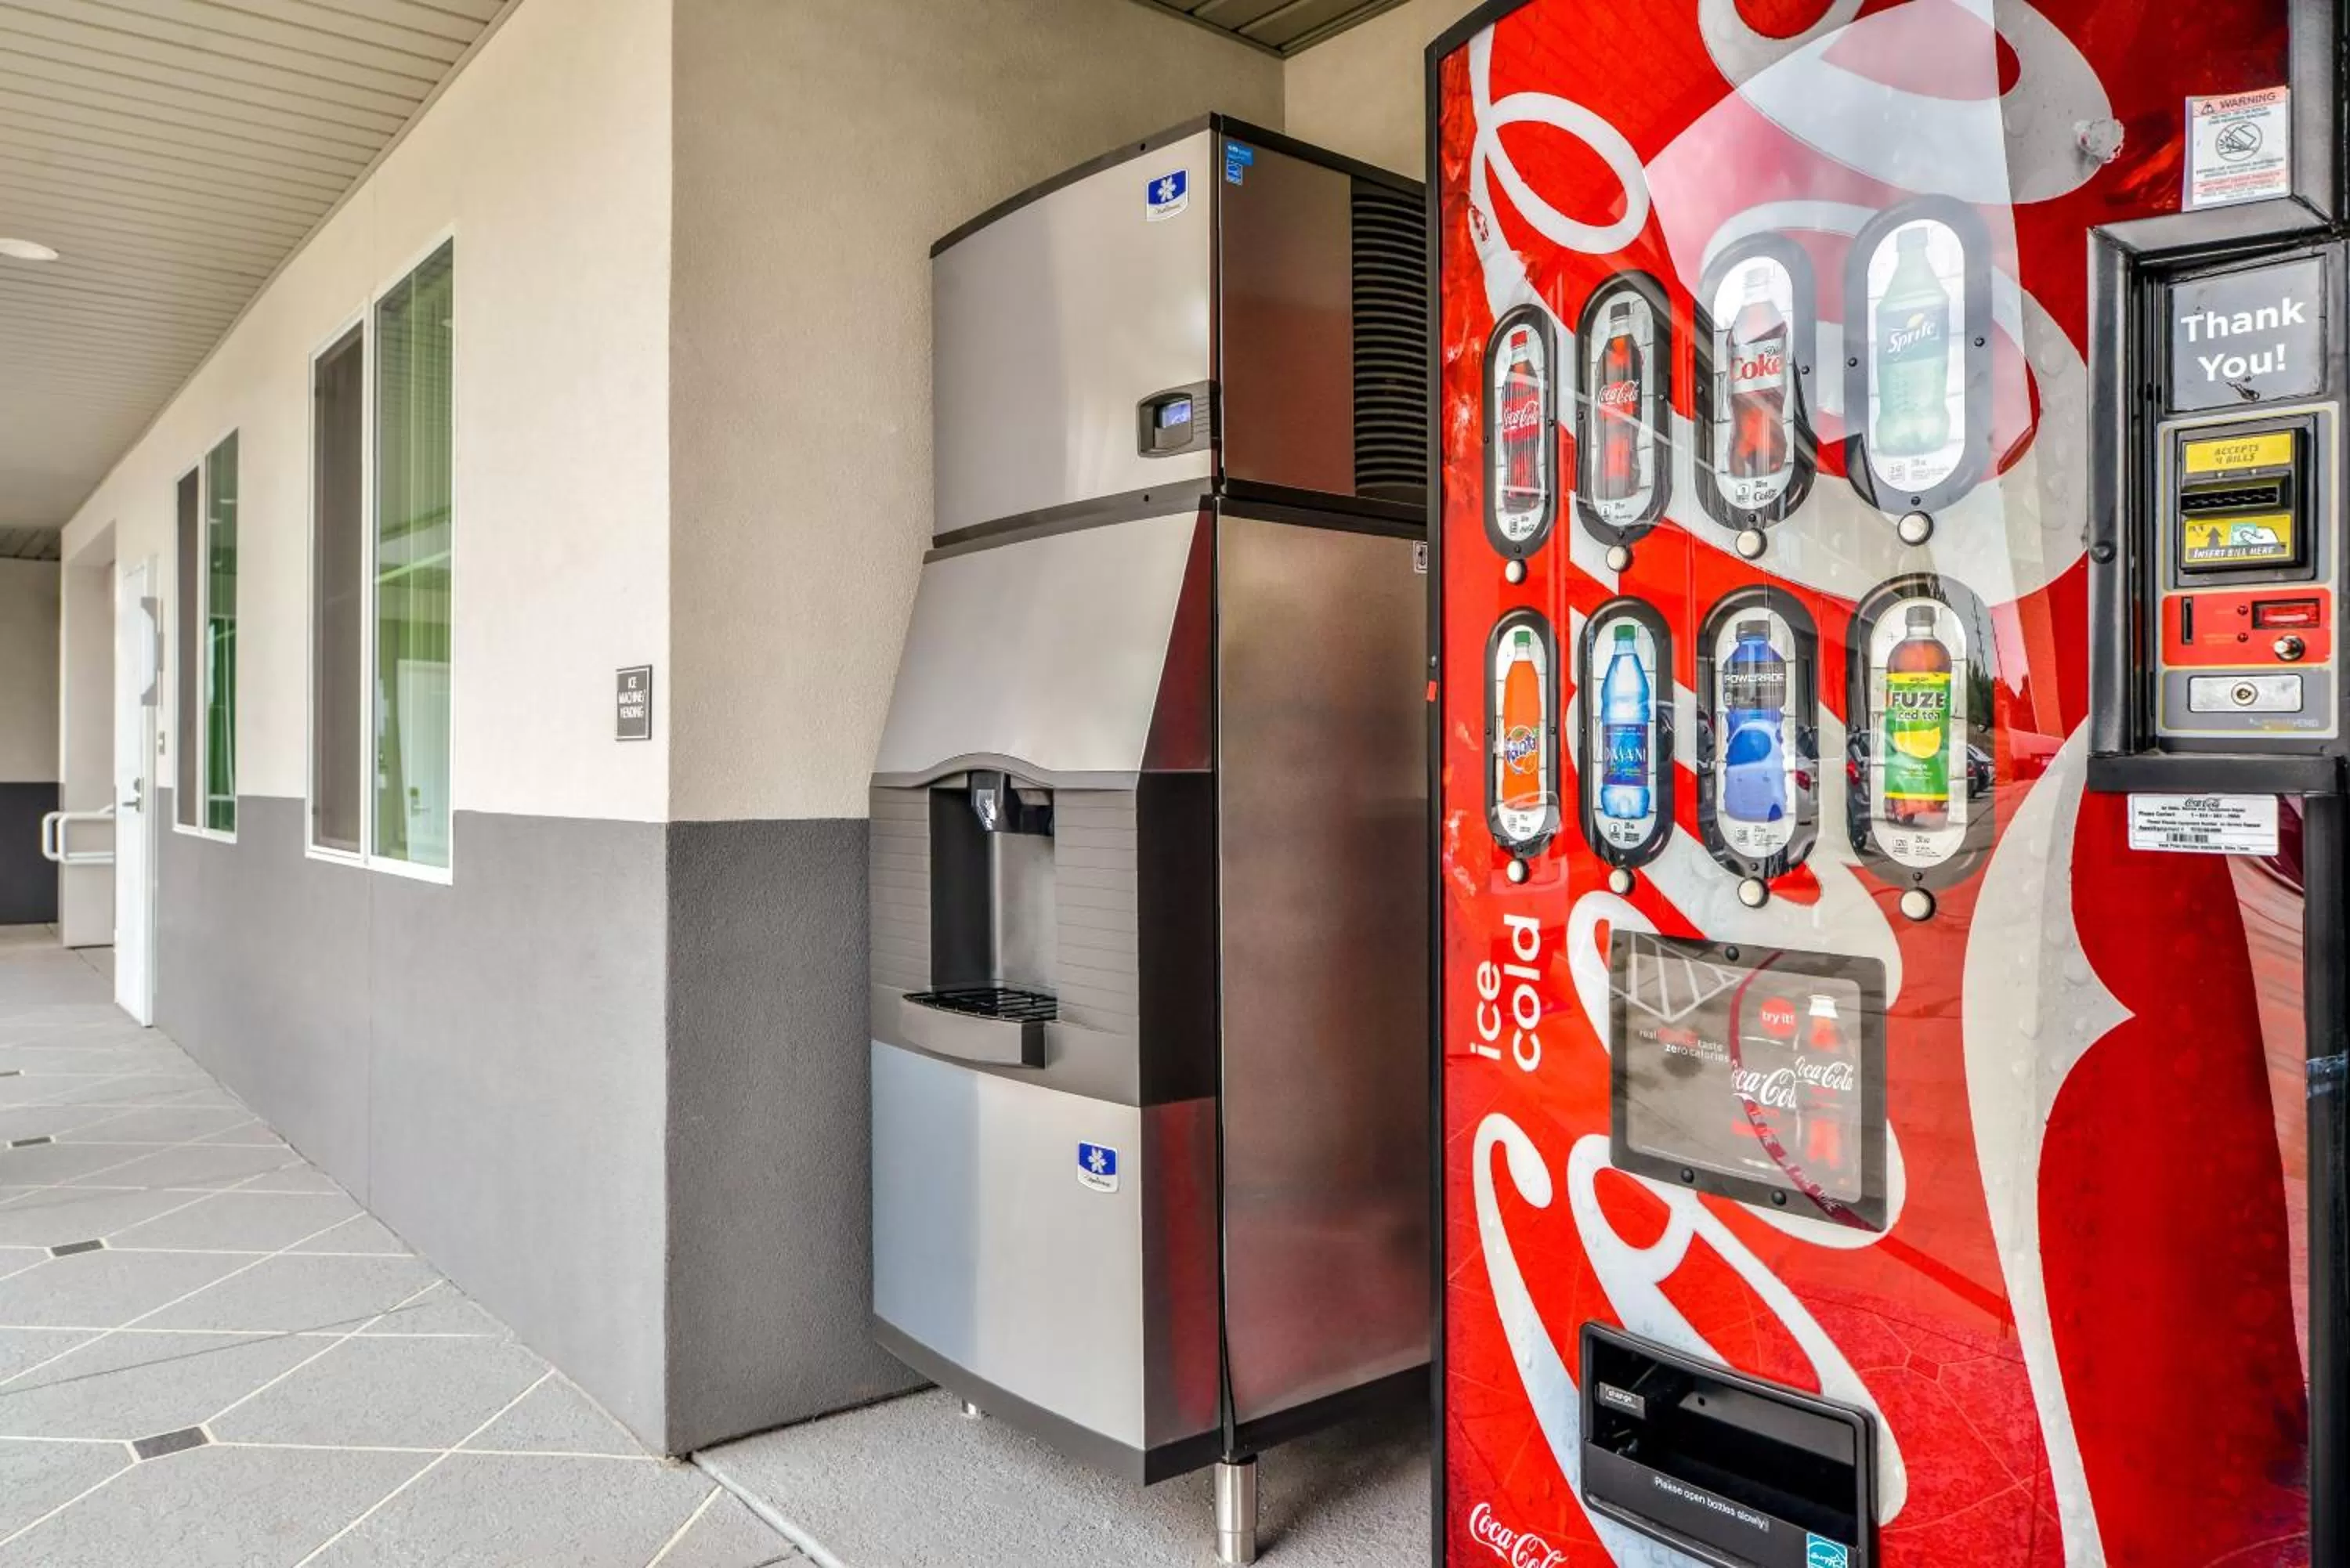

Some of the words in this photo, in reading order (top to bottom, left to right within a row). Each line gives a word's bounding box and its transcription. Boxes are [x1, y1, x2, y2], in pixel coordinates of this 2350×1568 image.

[2220, 92, 2276, 109] WARNING
[2180, 297, 2306, 342] Thank
[1888, 321, 1936, 352] Sprite
[1730, 353, 1781, 382] Coke
[2197, 344, 2286, 381] You!
[2214, 444, 2259, 455] ACCEPTS
[2226, 452, 2256, 464] BILLS
[2194, 547, 2225, 558] INSERT
[1892, 692, 1946, 709] FUZE
[1922, 710, 1941, 721] tea
[1503, 913, 1542, 1073] cold
[1470, 959, 1502, 1060] ice
[1762, 1010, 1780, 1025] try
[1664, 1043, 1688, 1055] zero
[1654, 1476, 1683, 1495] Please
[1684, 1490, 1706, 1505] open
[1707, 1497, 1736, 1517] bottles
